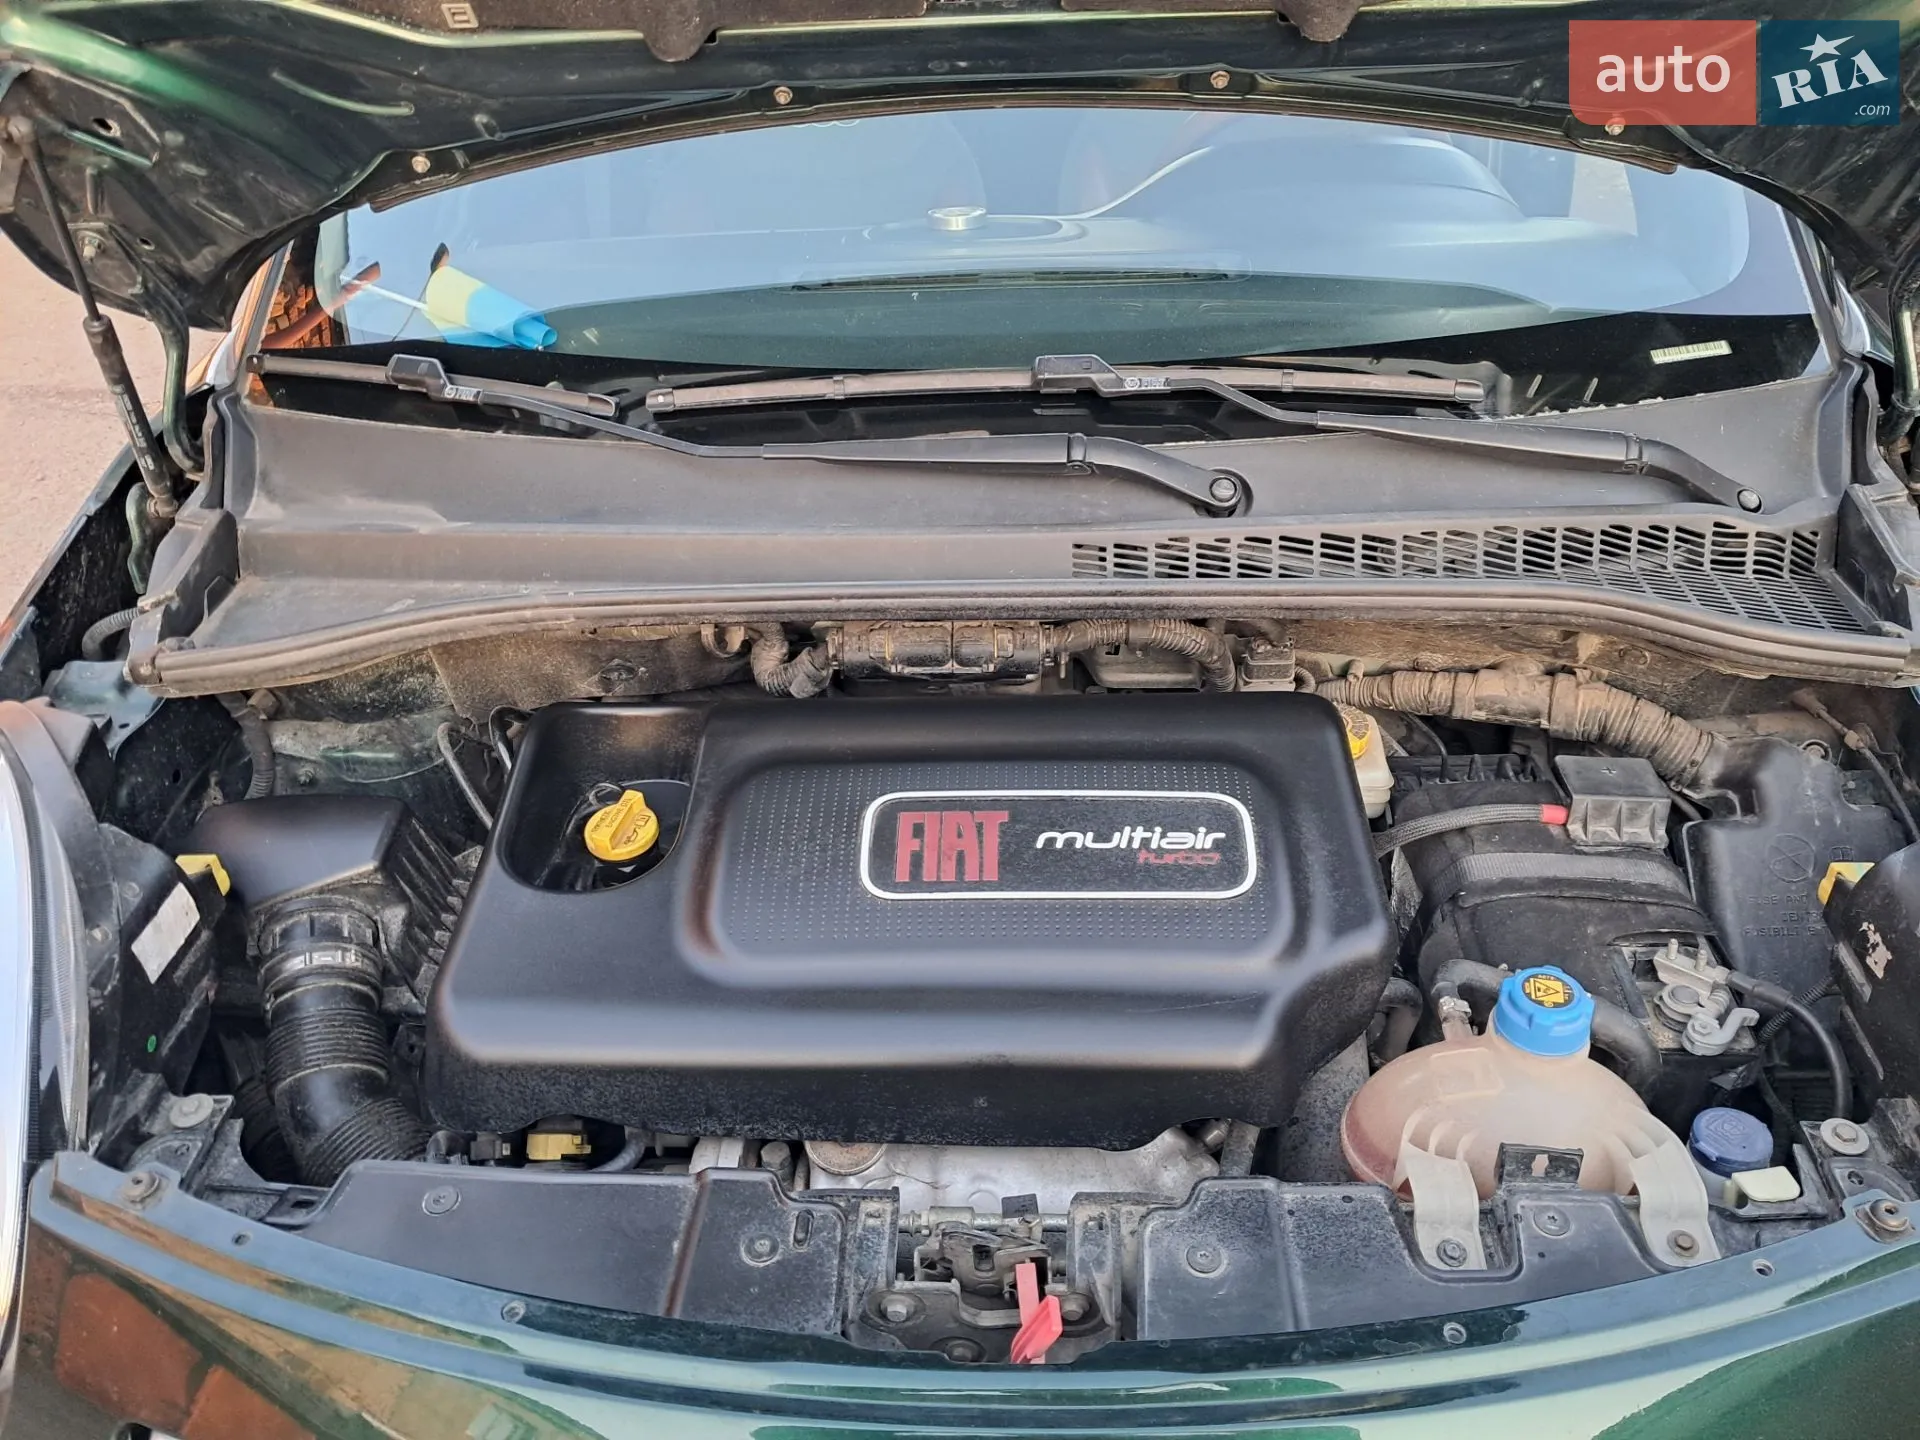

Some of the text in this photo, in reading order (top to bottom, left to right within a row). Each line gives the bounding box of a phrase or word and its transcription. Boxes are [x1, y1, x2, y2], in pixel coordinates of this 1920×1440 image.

[895, 811, 1009, 883] FIAT
[1035, 826, 1227, 850] multiair
[1138, 848, 1222, 865] turbo
[1747, 894, 1778, 905] FSE
